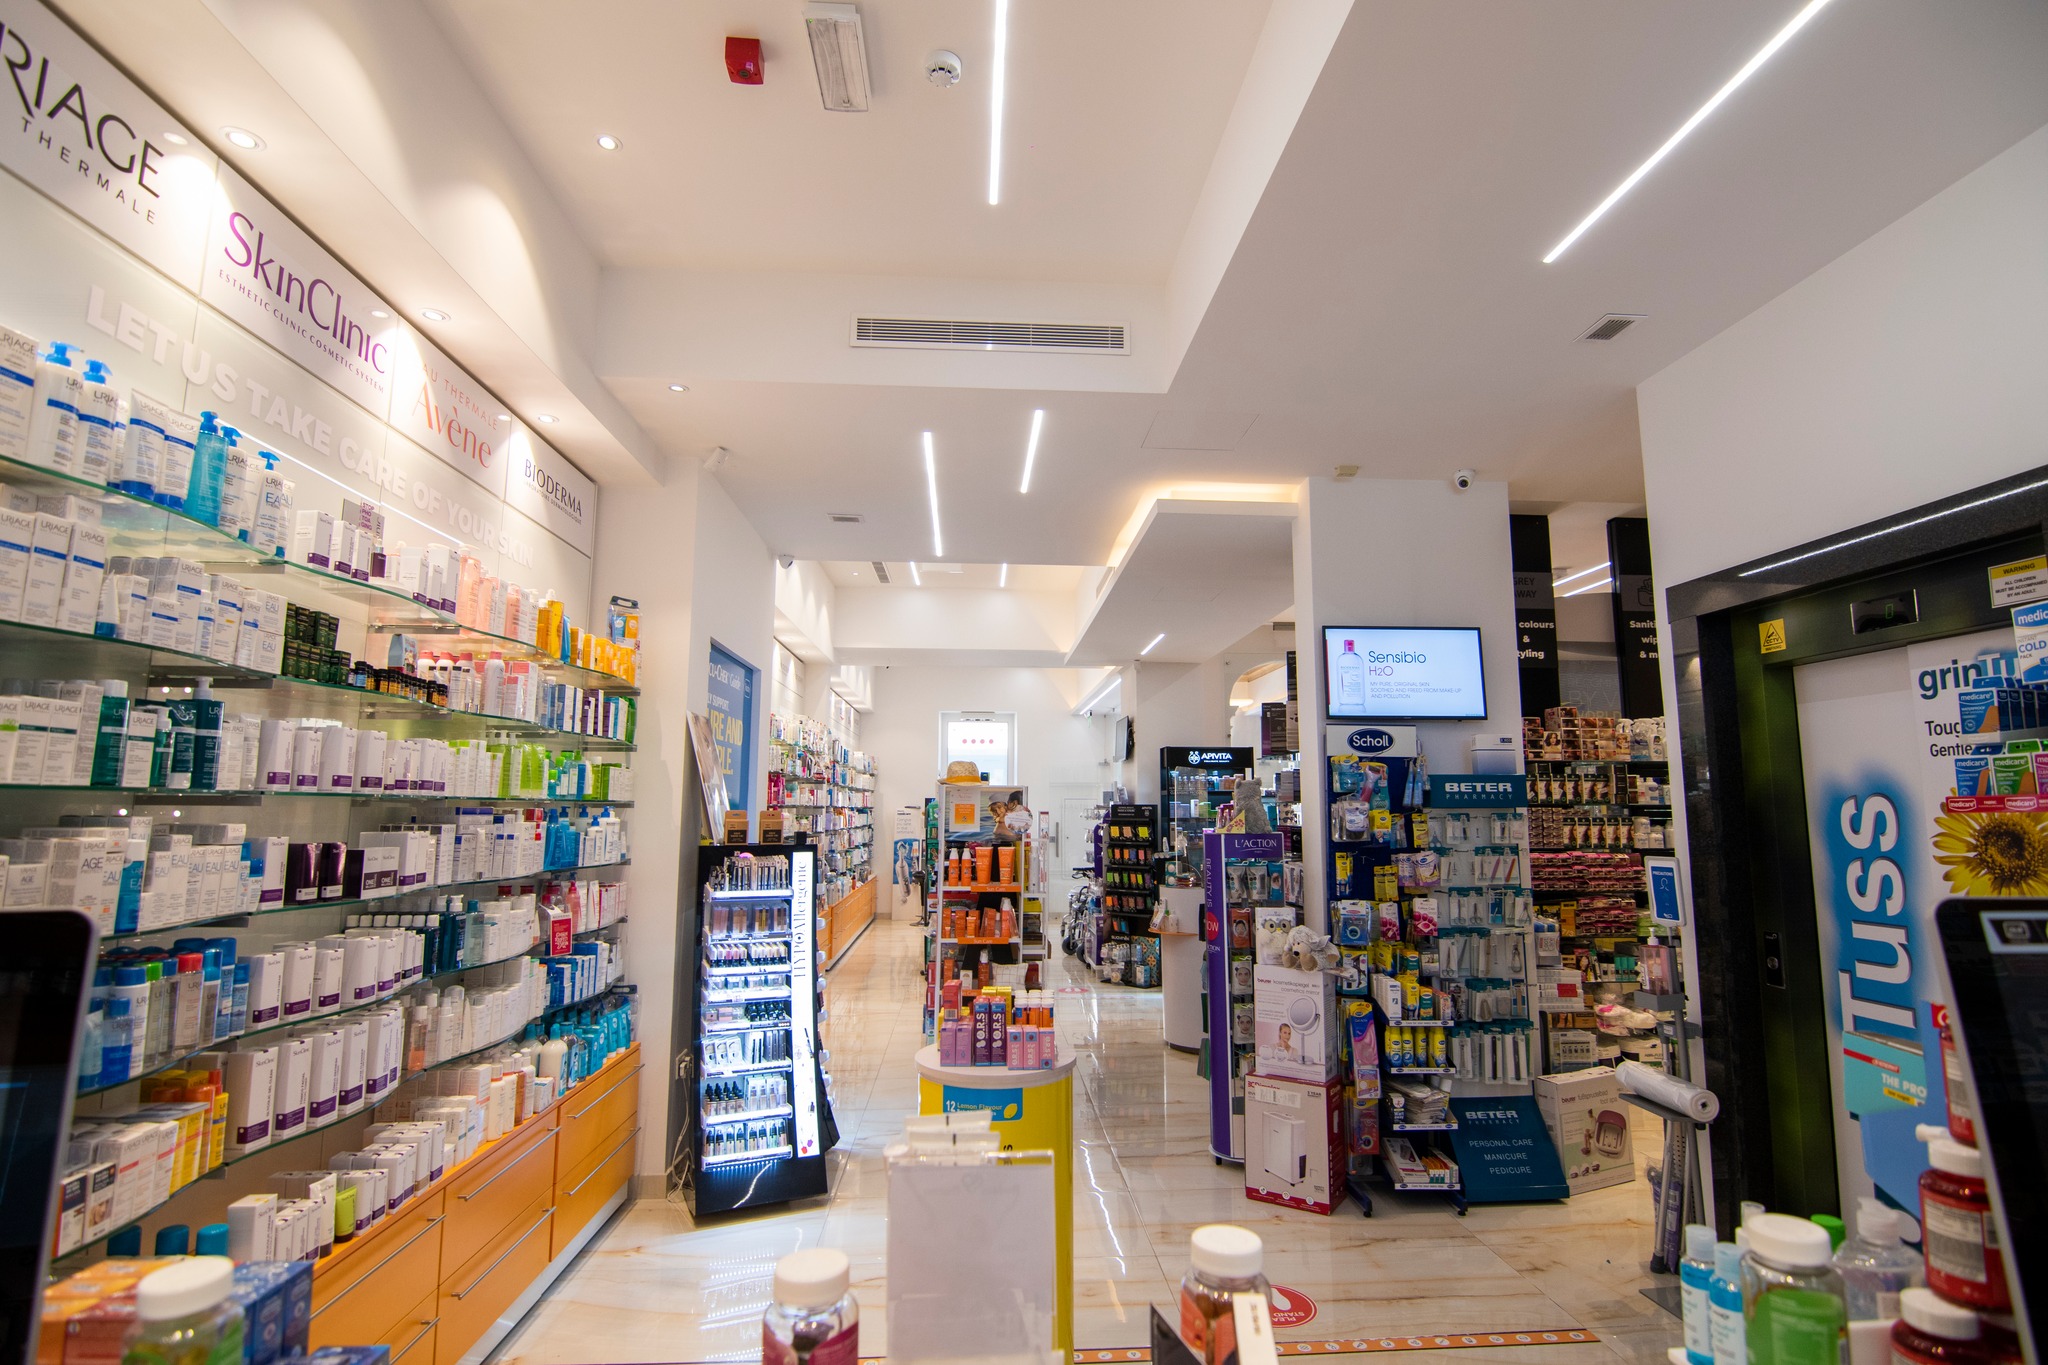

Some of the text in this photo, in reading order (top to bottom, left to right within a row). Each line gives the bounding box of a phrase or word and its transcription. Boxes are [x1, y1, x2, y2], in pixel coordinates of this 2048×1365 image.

[0, 20, 164, 198] RIAGE
[22, 116, 156, 224] THERMALE
[219, 269, 385, 394] ESTHETIC CLINIC COSMETIC SYSTEM
[443, 379, 499, 431] THERMALE
[87, 284, 178, 366] LET
[181, 340, 239, 403] US
[246, 378, 334, 454] TAKE
[339, 437, 407, 500] CARE
[413, 480, 442, 515] OF
[447, 498, 495, 549] YOUR
[499, 535, 534, 569] SKIN
[412, 380, 492, 469] Avène
[524, 458, 582, 518] BIODERMA
[2002, 562, 2036, 575] WARNING
[2013, 575, 2037, 584] CHILDREN
[2014, 579, 2048, 590] ACCOMPANIED
[1518, 620, 1555, 629] colours
[1522, 635, 1531, 643] &
[2018, 640, 2047, 653] COLD
[1368, 650, 1427, 664] Sensibio
[1639, 651, 1647, 659] &
[1369, 665, 1394, 677] H2O
[725, 716, 744, 747] AND
[1352, 734, 1390, 747] Scholl
[1201, 752, 1233, 761] APIVITA
[1445, 782, 1513, 793] BETER
[81, 858, 104, 870] AGE
[171, 854, 190, 866] EAU
[223, 860, 240, 871] EAU
[205, 861, 221, 873] EAU
[1838, 792, 1917, 1032] Tuss
[1882, 1072, 1927, 1098] THE PRO
[946, 1100, 956, 1112] 12
[1465, 1110, 1518, 1119] BETER
[1469, 1139, 1534, 1147] PERSONAL CARE
[1484, 1153, 1528, 1161] MANICURE
[1489, 1166, 1532, 1175] PEDICURE
